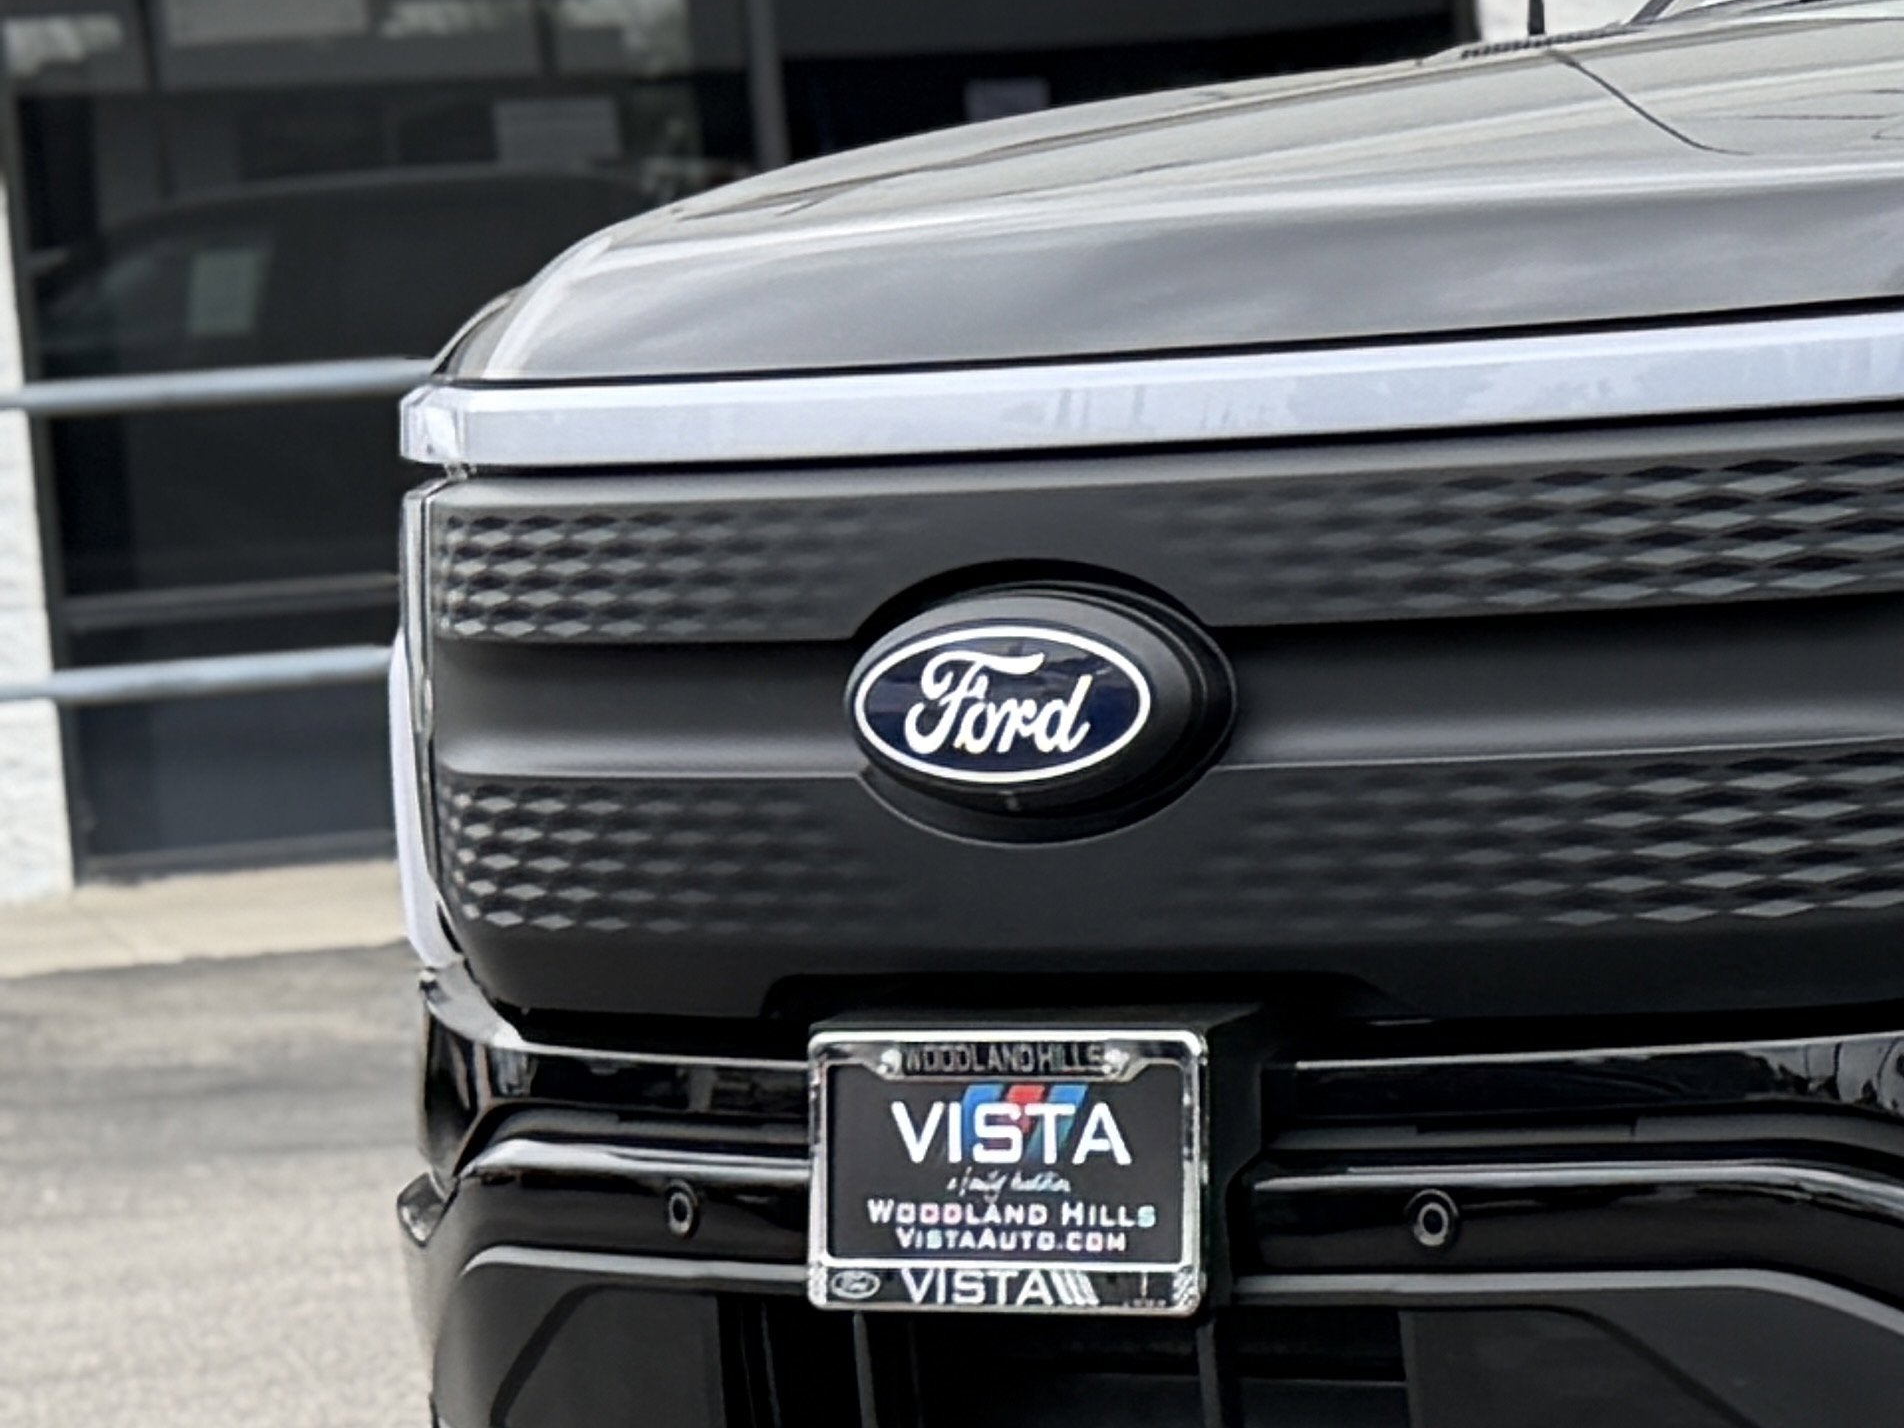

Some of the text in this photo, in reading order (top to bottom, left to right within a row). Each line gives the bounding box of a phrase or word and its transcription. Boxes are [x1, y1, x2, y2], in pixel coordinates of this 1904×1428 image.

[904, 650, 1093, 755] Ford
[904, 1043, 1102, 1072] WOODLAND HILLS
[890, 1101, 1133, 1166] VISTA
[867, 1198, 1157, 1228] WOODLAND HILLS
[901, 1268, 1055, 1306] VISTA
